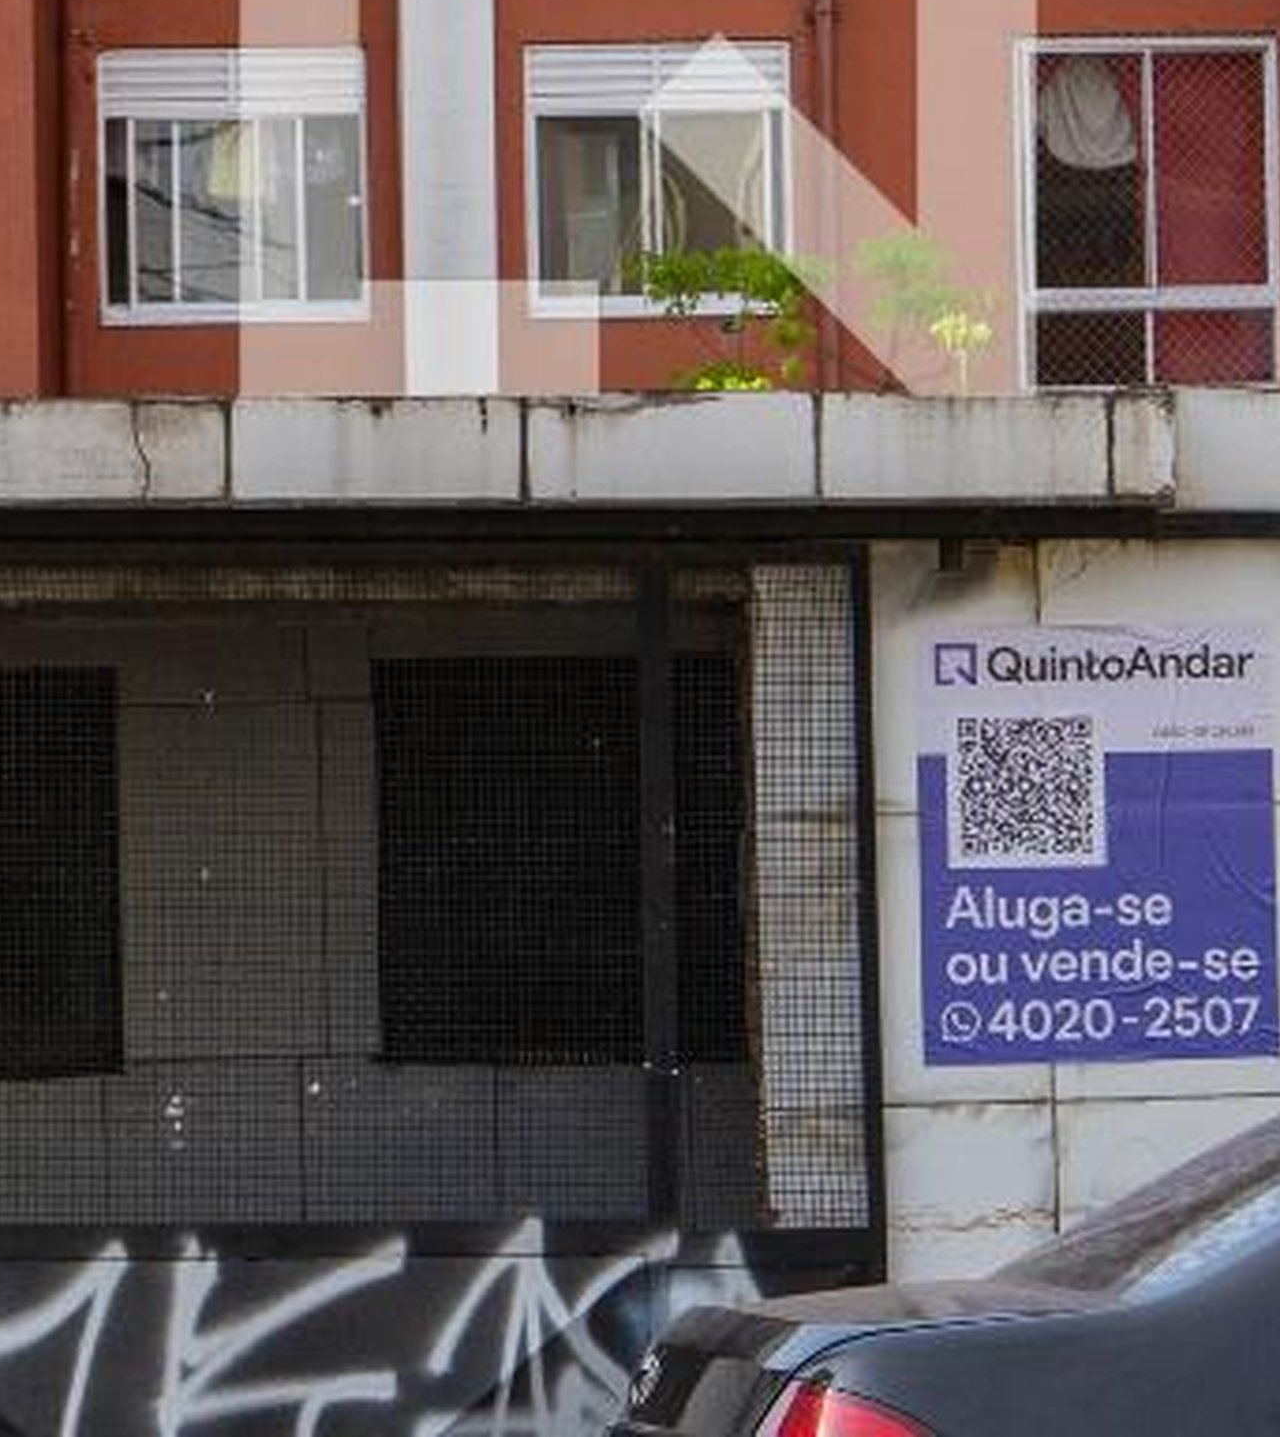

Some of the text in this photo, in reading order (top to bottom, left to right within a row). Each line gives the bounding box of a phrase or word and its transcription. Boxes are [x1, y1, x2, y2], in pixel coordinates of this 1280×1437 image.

[986, 645, 1254, 683] QuintoAndar
[945, 887, 1173, 936] Aluga-se
[946, 940, 1260, 984] ou vende-se
[986, 996, 1261, 1041] 4020-2507
